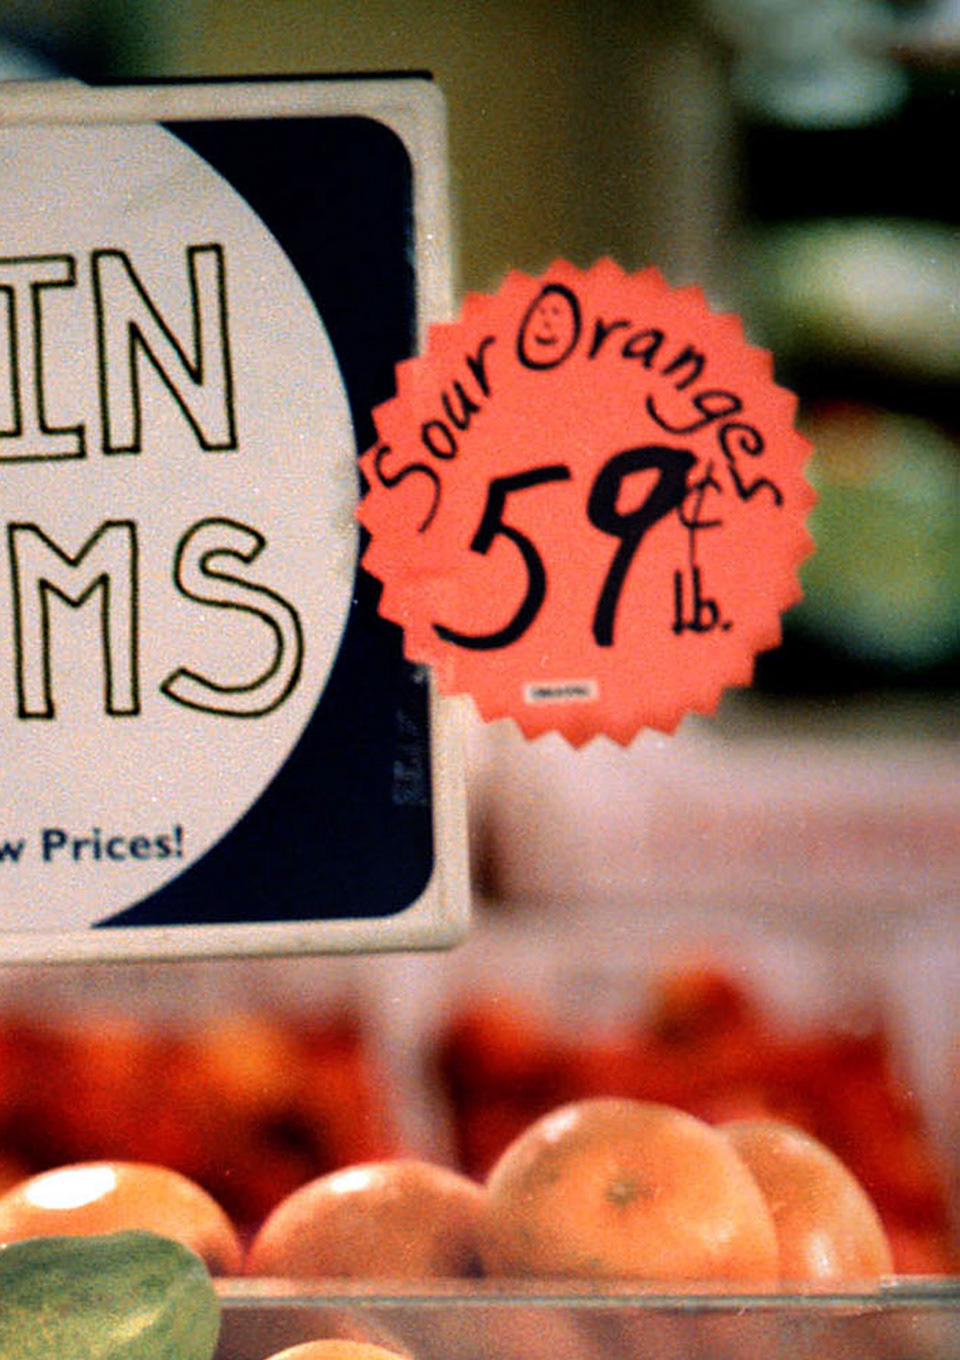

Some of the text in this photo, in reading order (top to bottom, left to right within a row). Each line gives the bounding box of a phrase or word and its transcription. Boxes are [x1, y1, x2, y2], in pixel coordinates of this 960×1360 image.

[373, 282, 784, 534] Sour Oranges
[42, 823, 185, 863] Prices!
